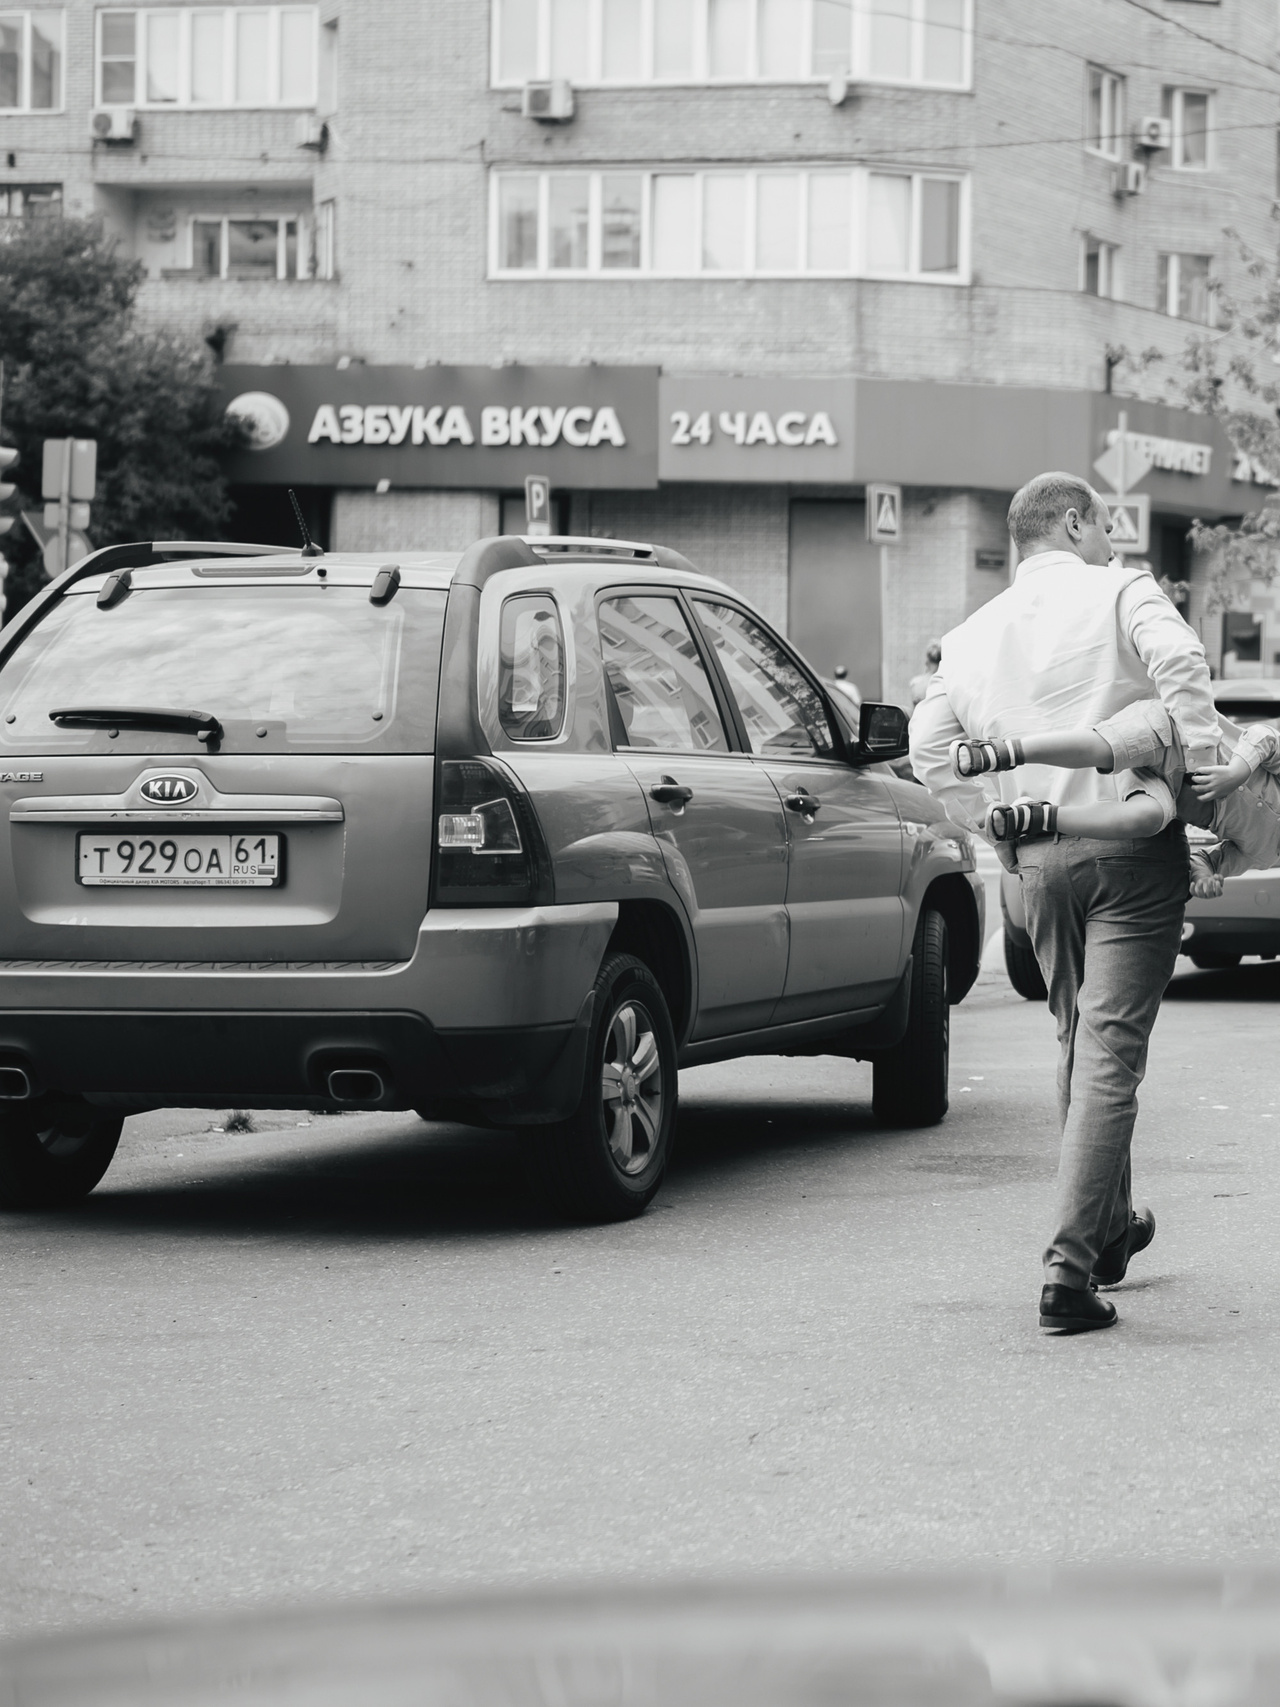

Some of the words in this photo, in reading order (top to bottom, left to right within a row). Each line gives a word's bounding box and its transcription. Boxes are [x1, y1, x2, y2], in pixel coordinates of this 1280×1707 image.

[308, 404, 475, 446] АЗБУКА
[481, 405, 626, 447] ВКУСА
[670, 410, 712, 445] 24
[719, 410, 838, 446] ЧАСА
[531, 483, 545, 519] P
[149, 781, 187, 797] KIA
[235, 838, 266, 864] 61
[233, 865, 257, 874] RUS
